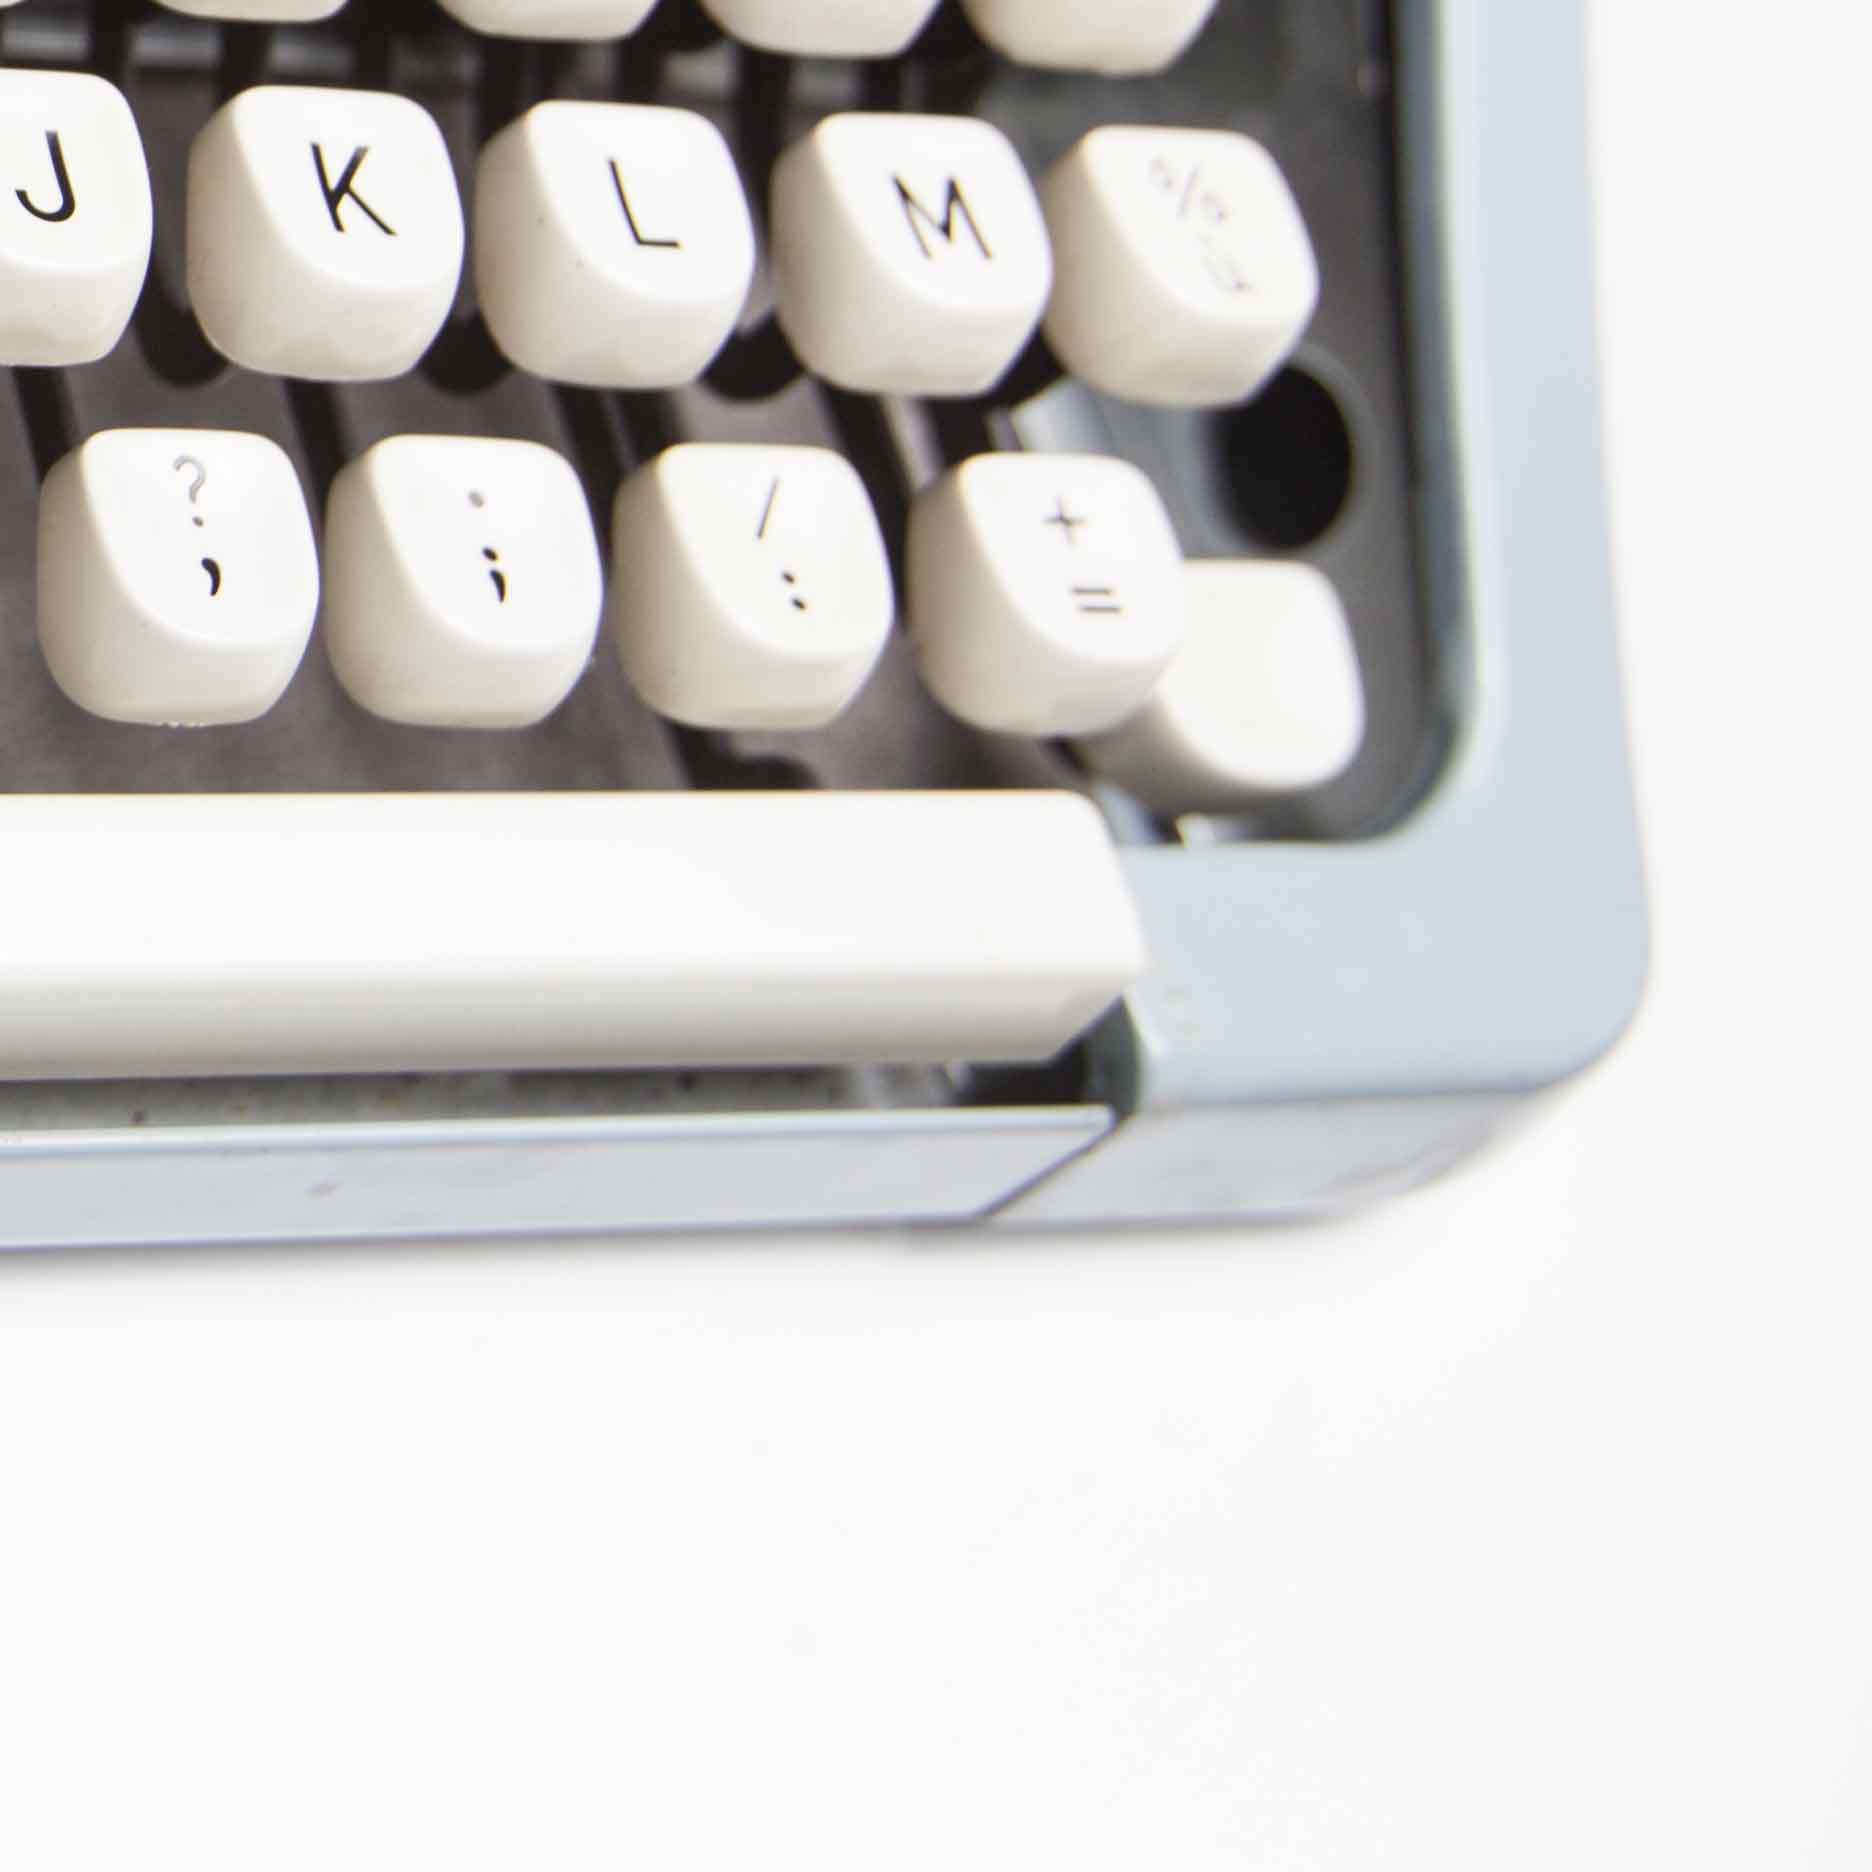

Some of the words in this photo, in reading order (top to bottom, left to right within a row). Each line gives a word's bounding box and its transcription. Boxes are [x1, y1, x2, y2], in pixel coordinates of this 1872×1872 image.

[15, 131, 76, 222] J
[311, 143, 395, 235] K
[608, 159, 680, 249] L
[893, 177, 990, 258] M
[171, 454, 208, 529] ?
[1042, 494, 1088, 544] +
